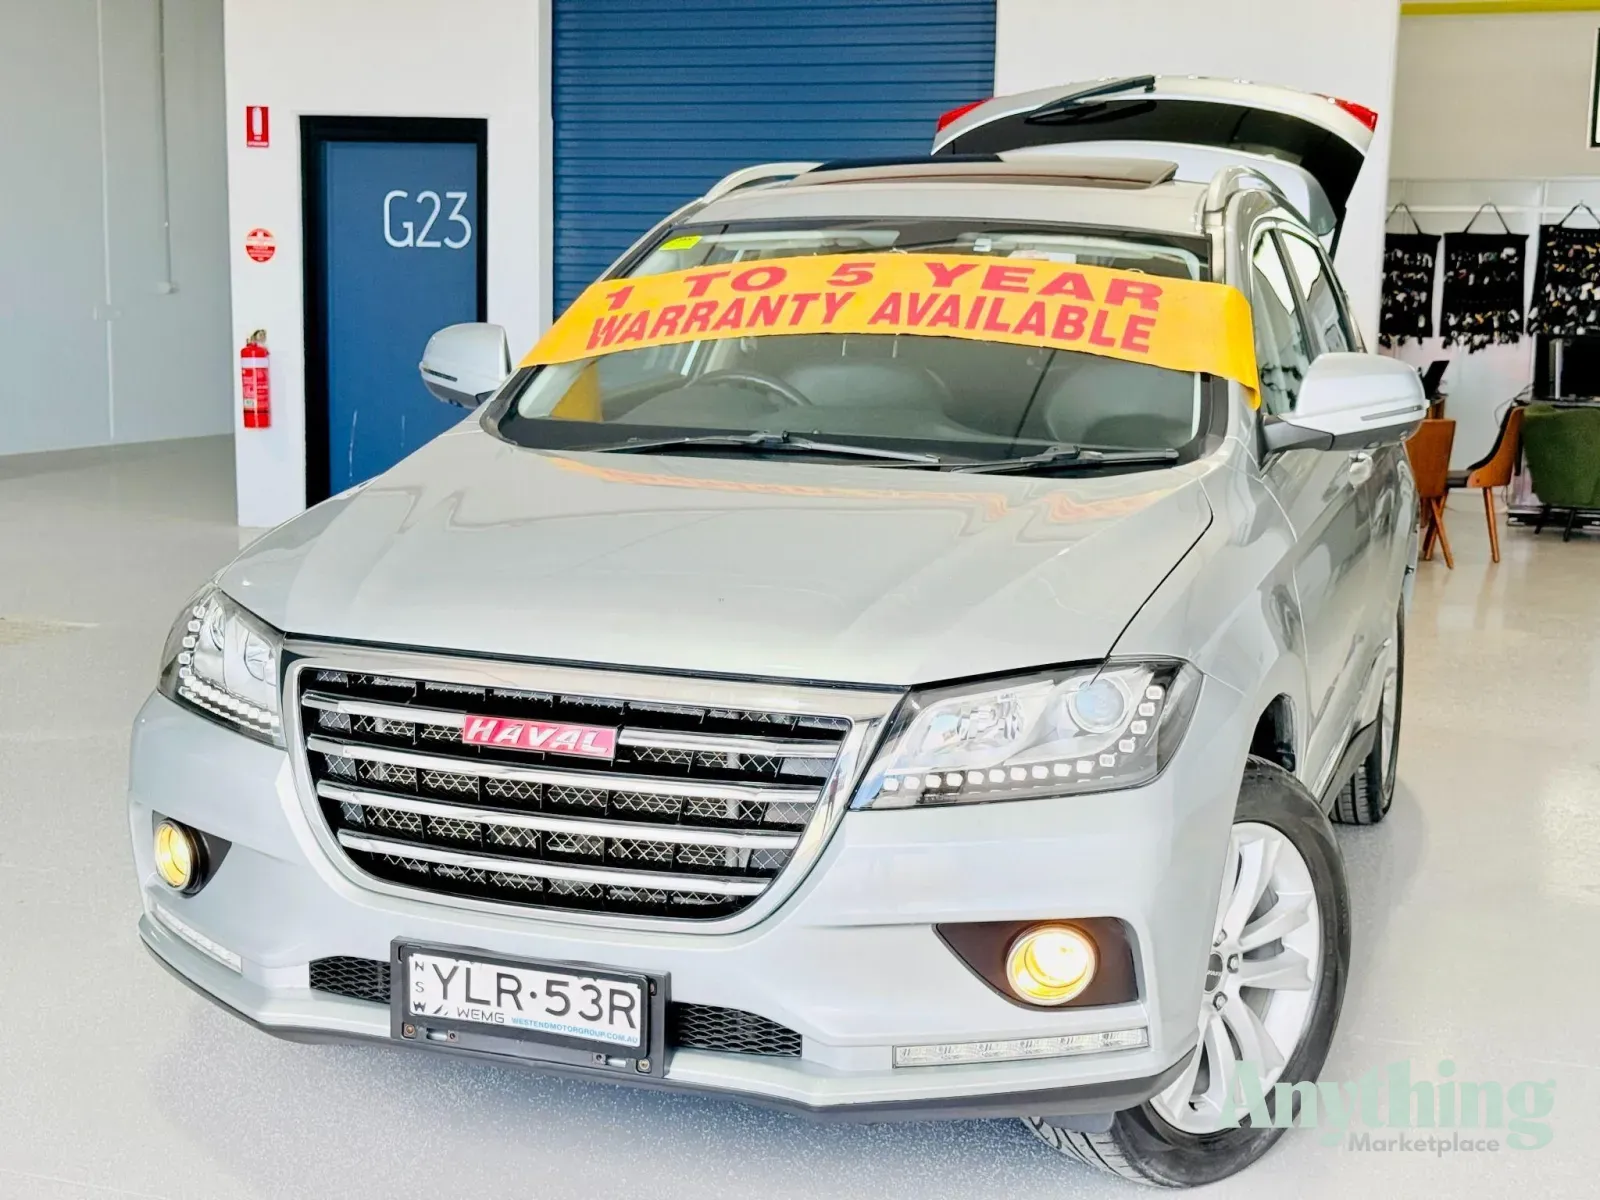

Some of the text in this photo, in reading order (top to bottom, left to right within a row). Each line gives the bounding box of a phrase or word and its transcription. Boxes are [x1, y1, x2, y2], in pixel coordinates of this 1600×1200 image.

[383, 189, 473, 249] G23
[605, 261, 1164, 312] 1 TO 5 YEAR
[586, 291, 1157, 354] WARRANTY AVAILABLE
[465, 718, 609, 753] HAVAL
[457, 1006, 505, 1024] WEMG
[511, 1017, 638, 1044] WESTENDMOTORGROUP.COM.AU
